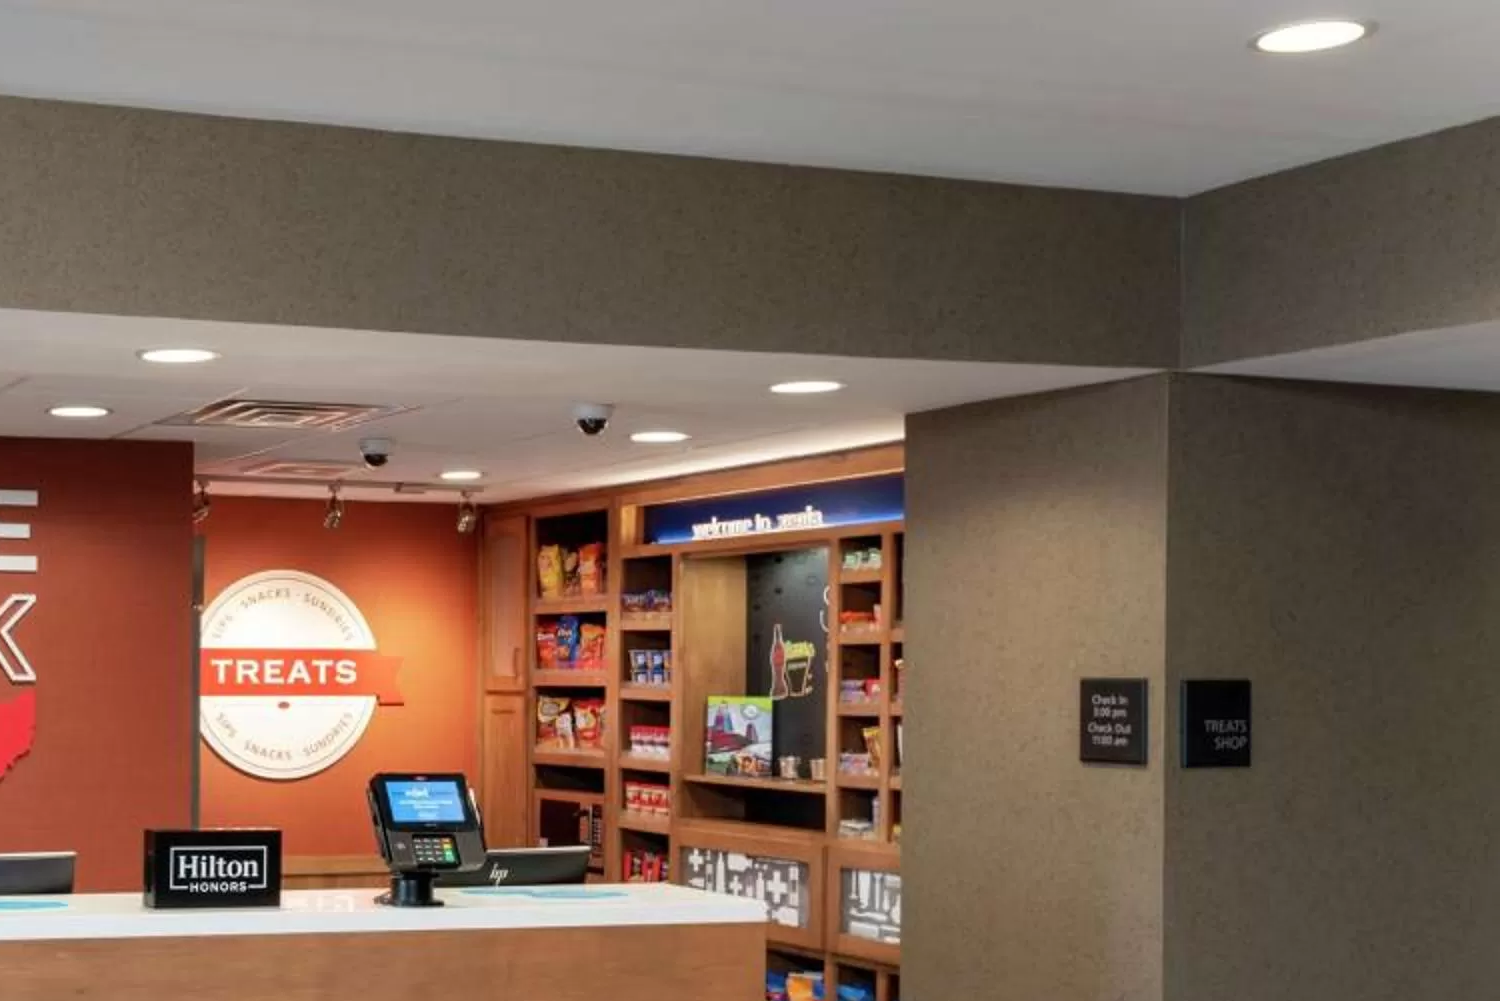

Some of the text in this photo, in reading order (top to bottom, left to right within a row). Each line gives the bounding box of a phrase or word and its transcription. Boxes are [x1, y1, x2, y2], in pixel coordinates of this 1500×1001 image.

[211, 658, 357, 685] TREATS
[1091, 694, 1116, 705] Check
[1087, 721, 1132, 734] Check Out
[1203, 719, 1247, 733] TREATS
[1214, 735, 1248, 750] SHOP
[243, 739, 293, 761] SNACKS
[178, 854, 259, 879] Hilton
[189, 881, 247, 893] HONORS
